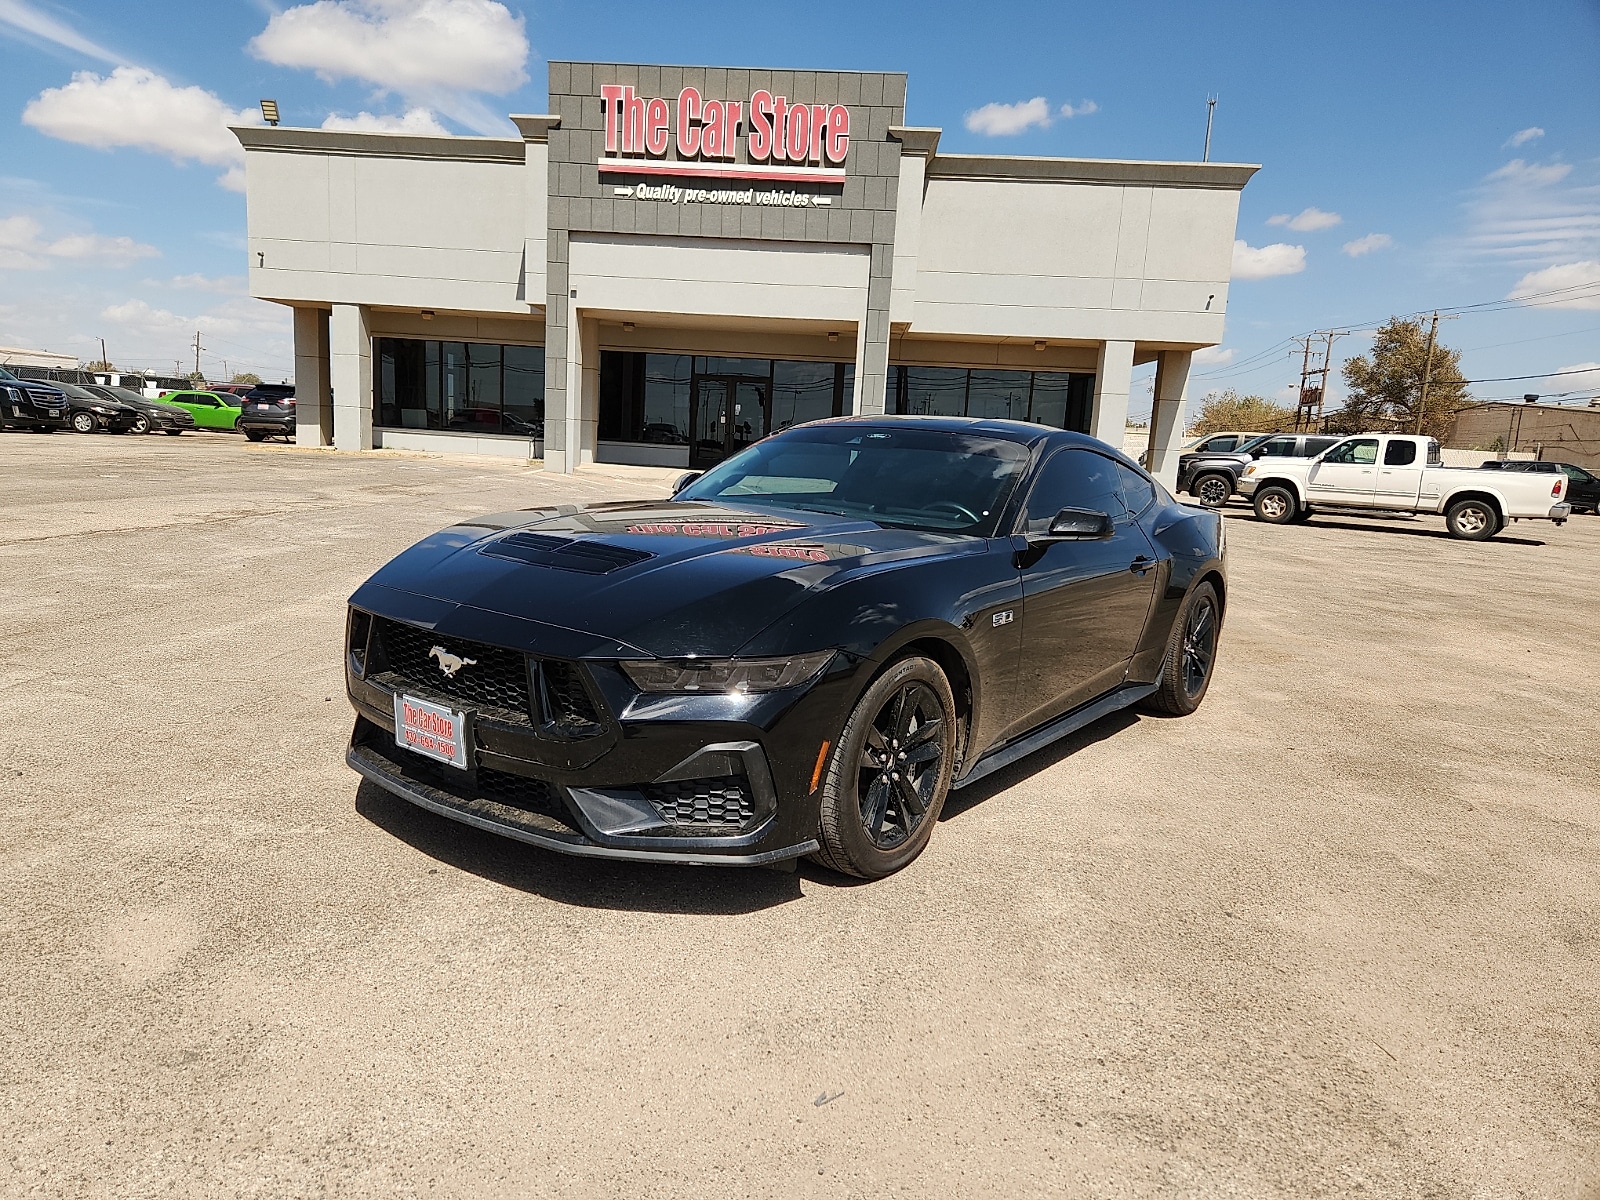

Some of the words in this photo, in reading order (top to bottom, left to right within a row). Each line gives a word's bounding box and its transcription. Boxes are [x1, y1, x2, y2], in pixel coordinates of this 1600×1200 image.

[601, 84, 670, 156] The
[676, 86, 743, 159] Car
[748, 89, 850, 163] Store
[636, 183, 682, 203] Quality
[683, 187, 754, 205] pre-owned
[755, 191, 810, 208] vehicles
[402, 701, 417, 726] The
[418, 707, 432, 730] Car
[431, 711, 454, 738] Store
